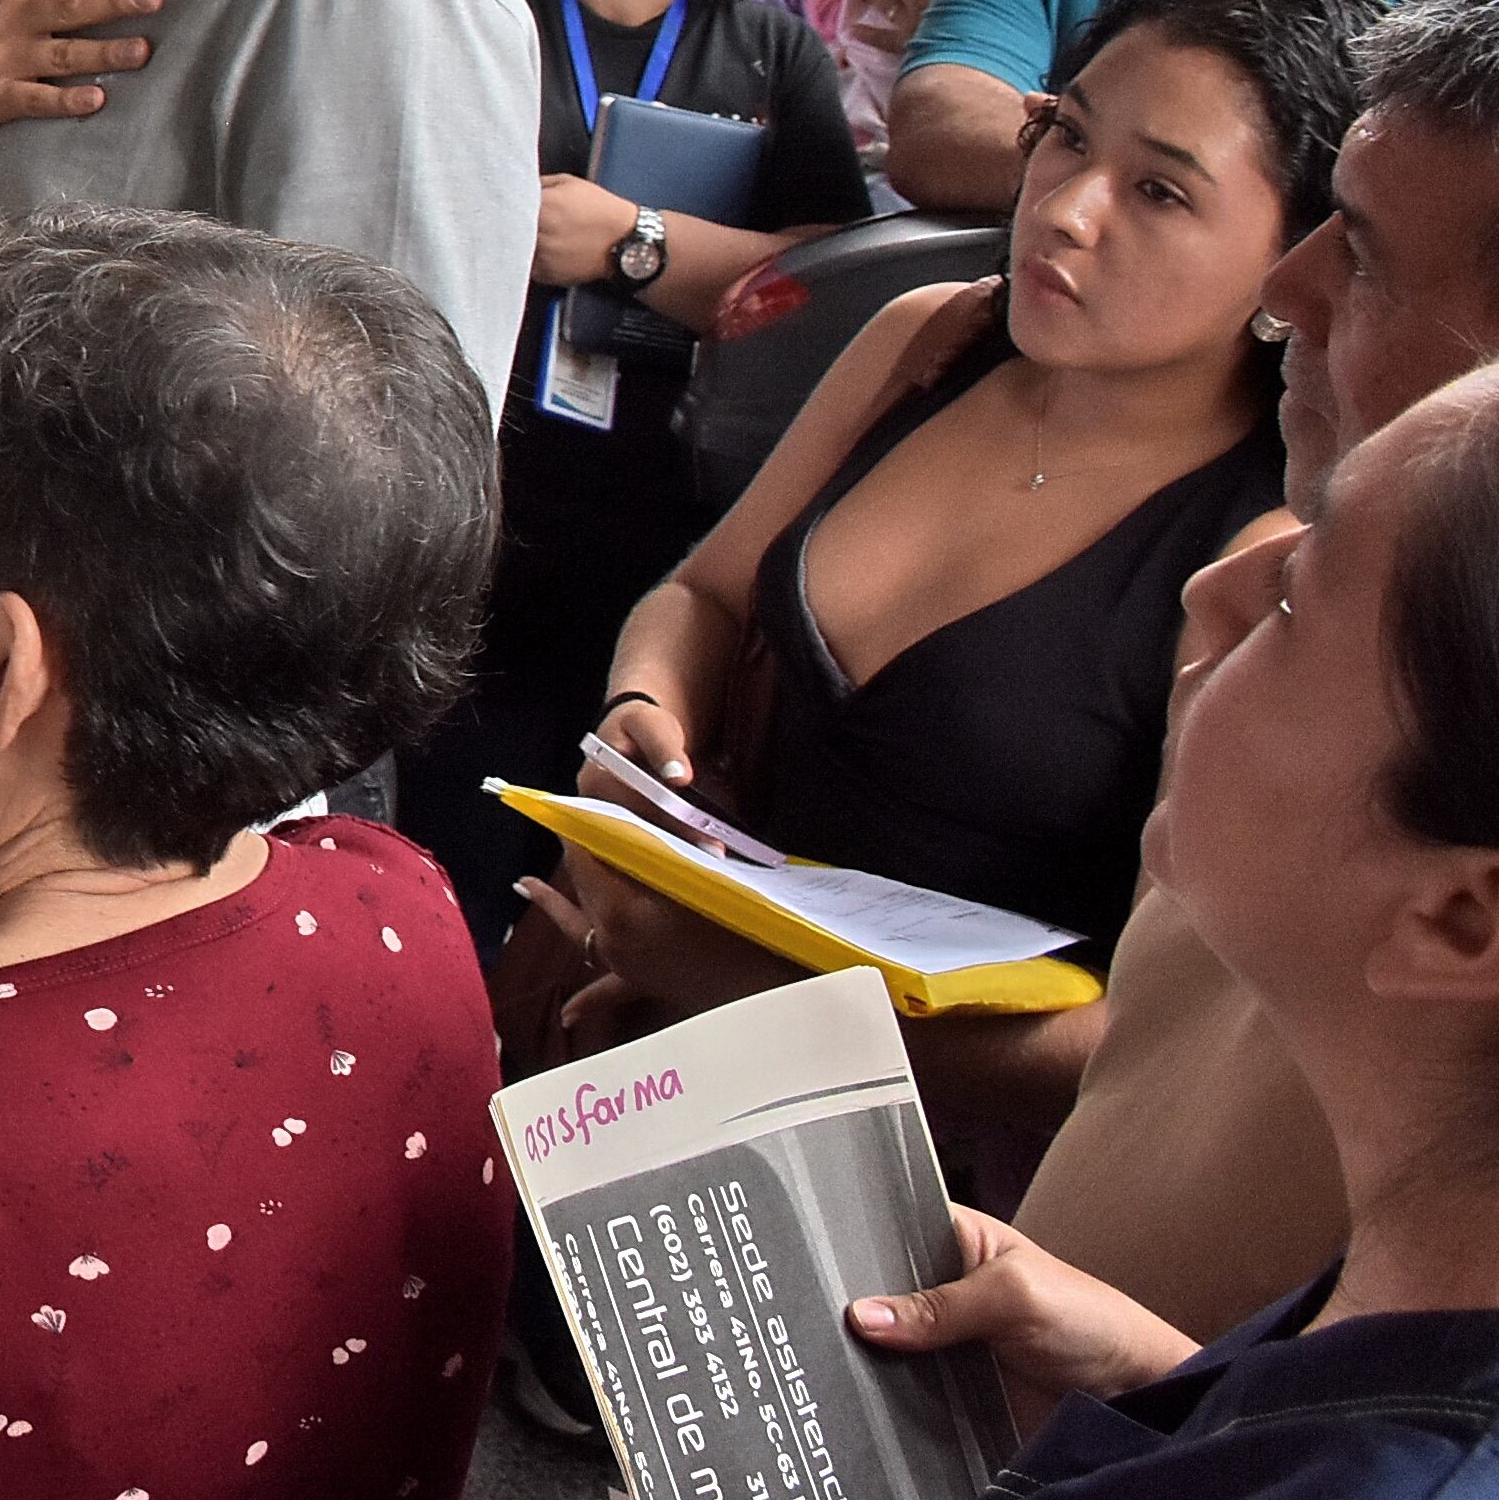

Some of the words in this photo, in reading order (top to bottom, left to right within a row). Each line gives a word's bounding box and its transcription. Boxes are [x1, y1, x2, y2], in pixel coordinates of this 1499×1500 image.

[524, 1068, 684, 1164] asisfarma
[565, 1232, 608, 1352] Carrera
[606, 1214, 689, 1380] Central
[666, 1393, 704, 1456] de
[649, 1204, 694, 1283] (602)
[682, 1288, 716, 1345] 393
[705, 1352, 740, 1420] 4132
[687, 1193, 734, 1309] Carrera
[730, 1316, 762, 1398] 41No.
[758, 1403, 801, 1490] 5C-63
[719, 1181, 774, 1304] Sede
[767, 1314, 848, 1500] asistenc
